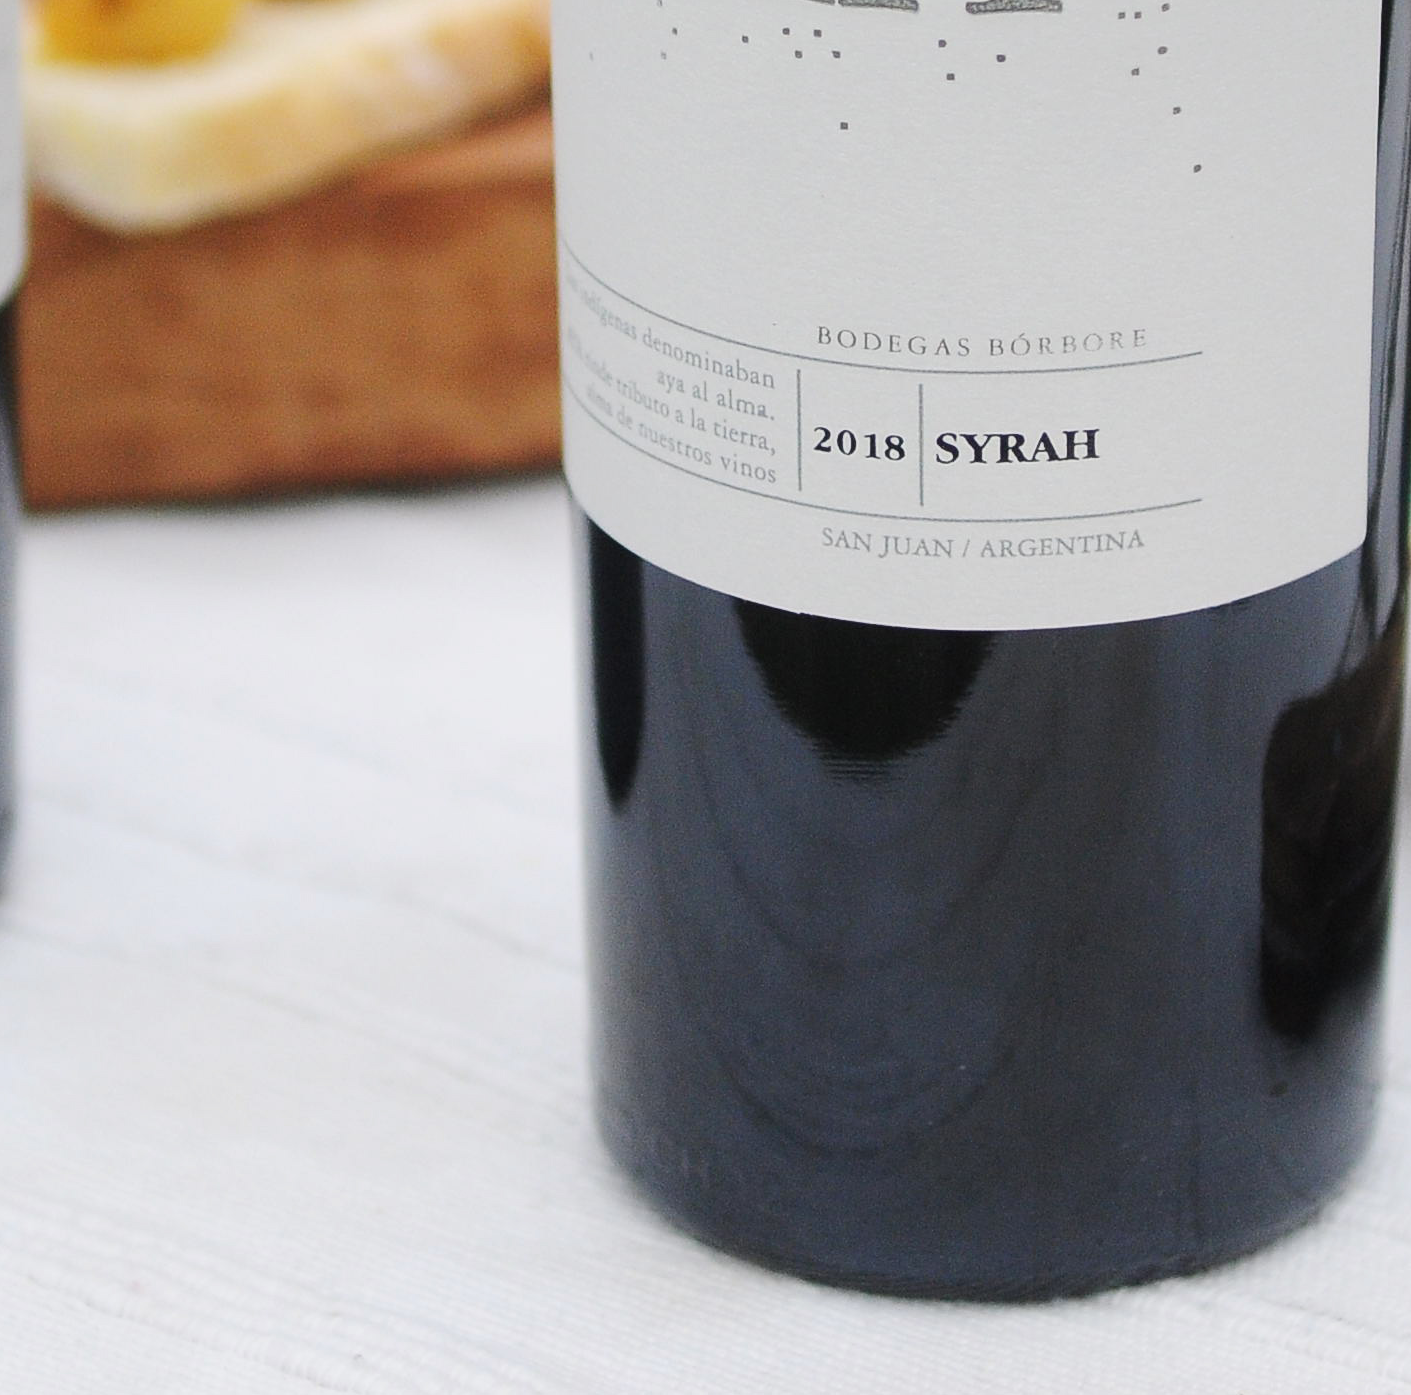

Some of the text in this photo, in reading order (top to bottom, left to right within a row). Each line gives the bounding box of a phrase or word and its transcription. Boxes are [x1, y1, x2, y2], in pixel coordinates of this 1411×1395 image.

[642, 327, 775, 389] denominaban
[818, 326, 1148, 357] BODEGAS BÓRBORE
[616, 378, 670, 418] tributo
[675, 409, 685, 424] a
[691, 407, 707, 432] la
[714, 419, 776, 456] tierra,
[657, 369, 775, 421] aya al alma.
[617, 405, 634, 430] de
[638, 422, 712, 466] nuestros
[720, 453, 777, 484] vinos
[813, 426, 1100, 465] 2018 SYRAH
[821, 527, 872, 553] SAN
[878, 535, 953, 559] JUAN
[980, 529, 1145, 559] ARGENTINA
